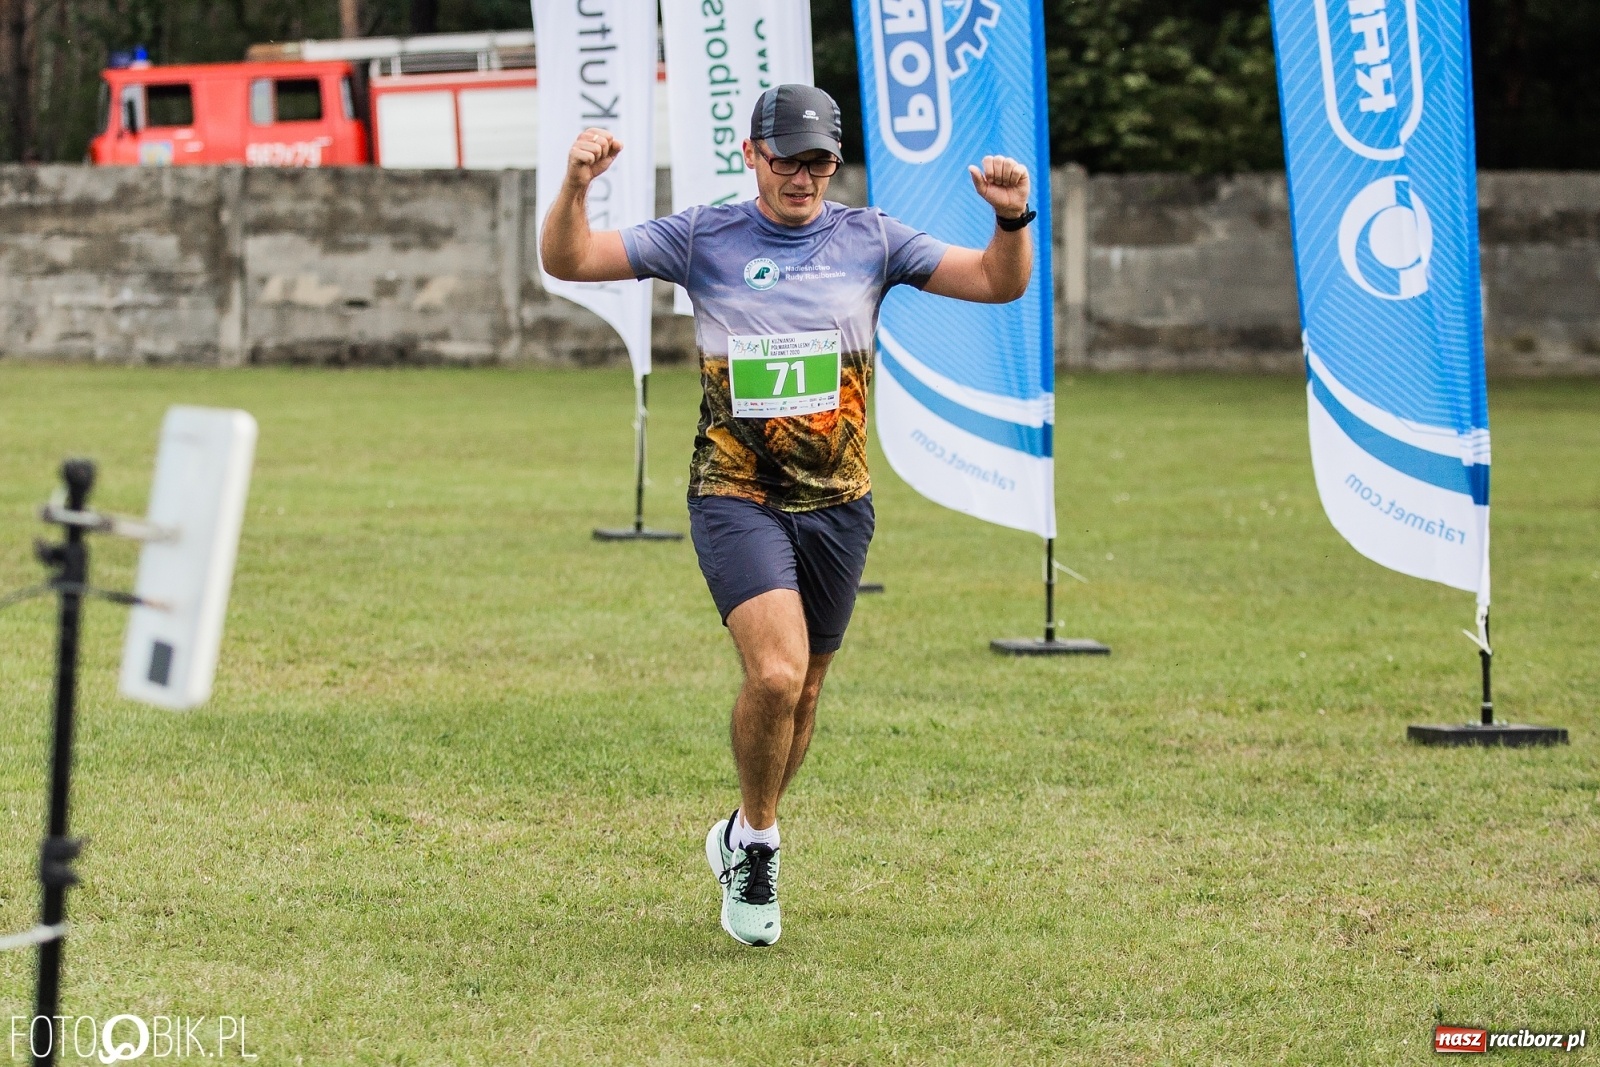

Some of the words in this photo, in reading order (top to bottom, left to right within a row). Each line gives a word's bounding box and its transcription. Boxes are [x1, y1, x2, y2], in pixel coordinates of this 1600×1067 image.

[785, 273, 804, 281] Rudy
[805, 271, 846, 280] Raciborskie
[760, 339, 770, 356] V
[766, 360, 806, 396] 71
